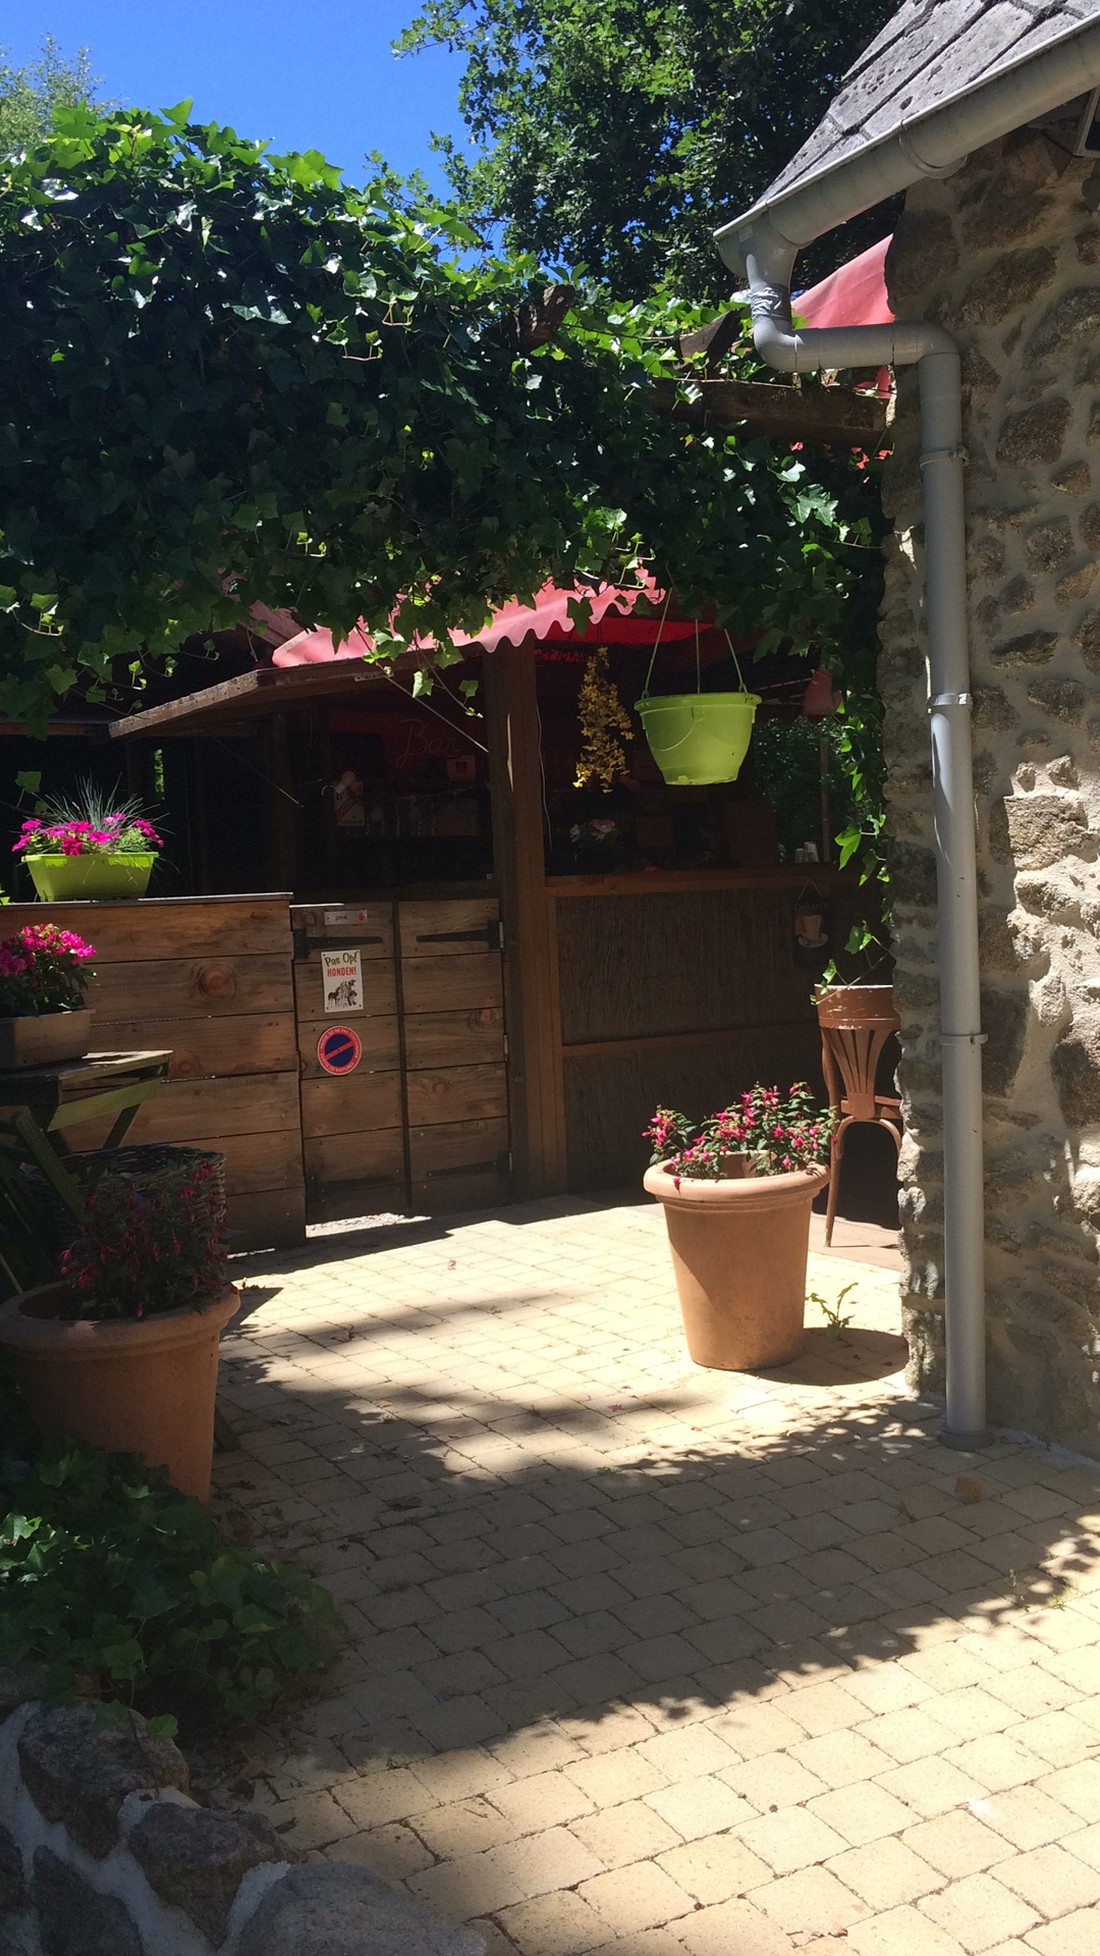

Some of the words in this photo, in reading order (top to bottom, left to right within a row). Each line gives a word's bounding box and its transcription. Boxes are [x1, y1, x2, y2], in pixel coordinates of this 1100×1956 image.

[396, 718, 461, 768] Bar
[325, 957, 340, 967] Pas
[343, 952, 357, 965] Op!
[327, 967, 357, 977] HONDEN!
